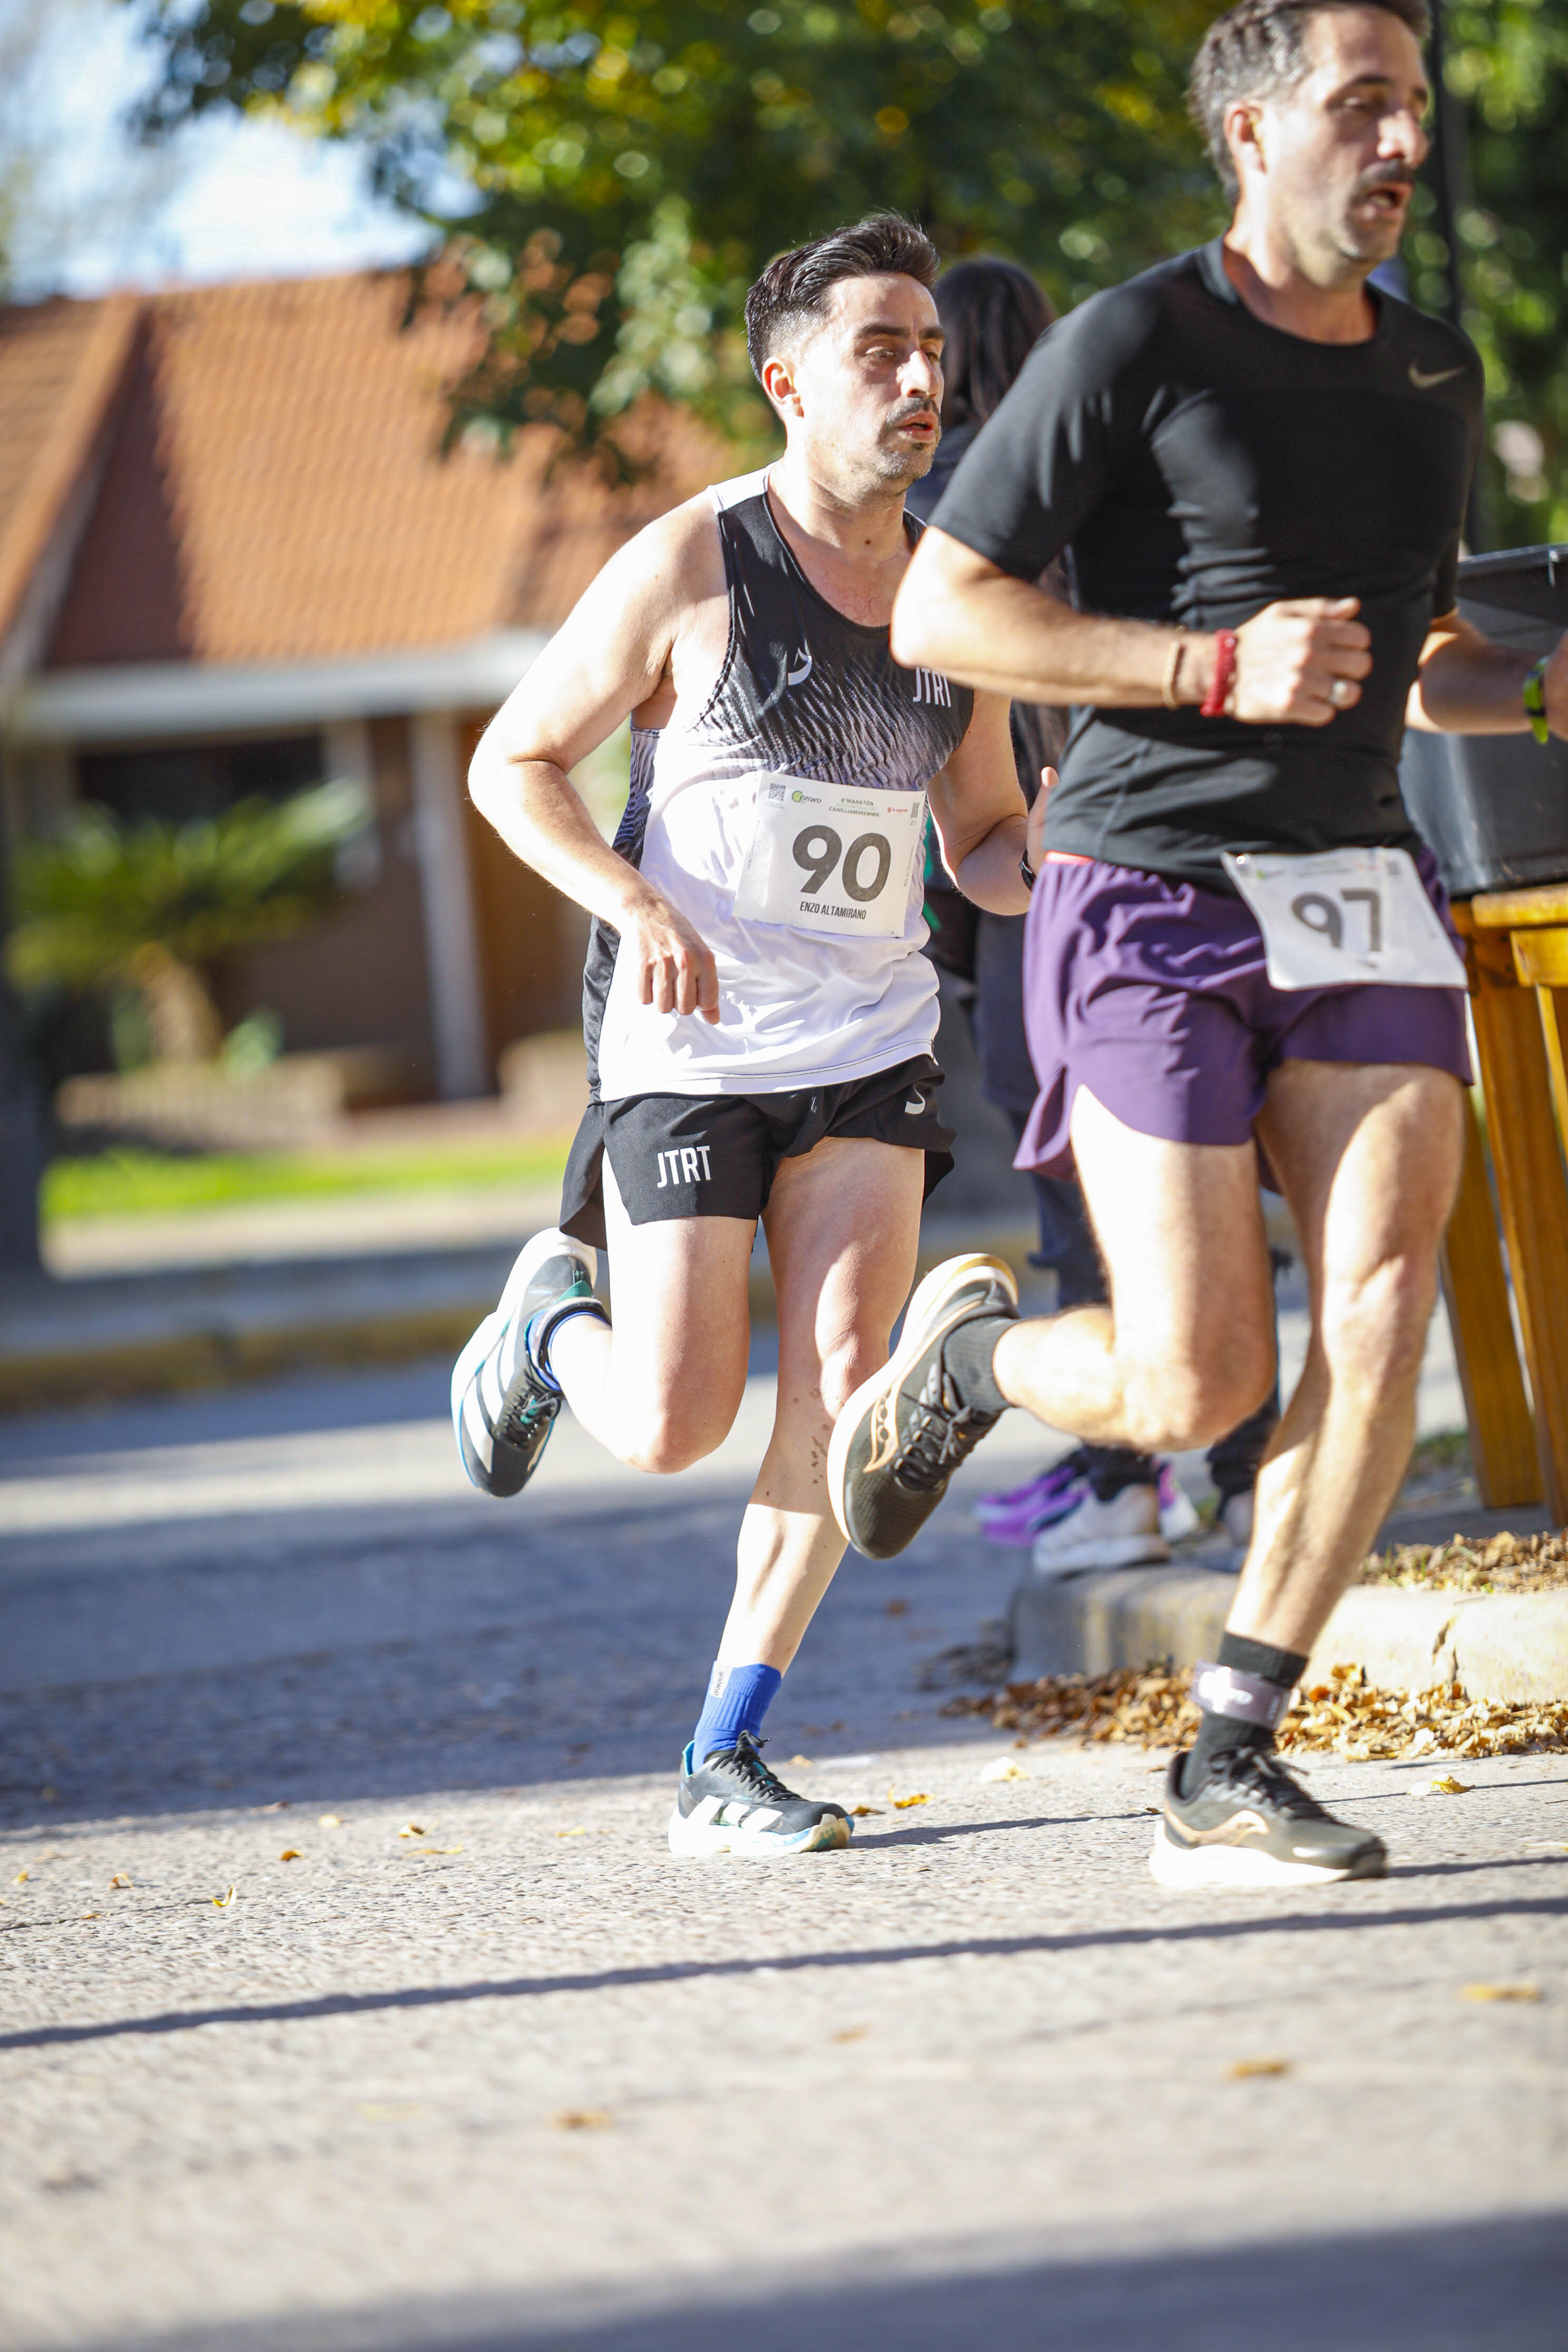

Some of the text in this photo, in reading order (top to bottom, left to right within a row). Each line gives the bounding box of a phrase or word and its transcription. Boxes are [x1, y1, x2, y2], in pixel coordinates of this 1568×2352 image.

[792, 824, 891, 902] 90
[800, 901, 867, 919] ENZO ALTAMIRANO
[1291, 888, 1381, 952] 97
[657, 1145, 711, 1188] JTRT
